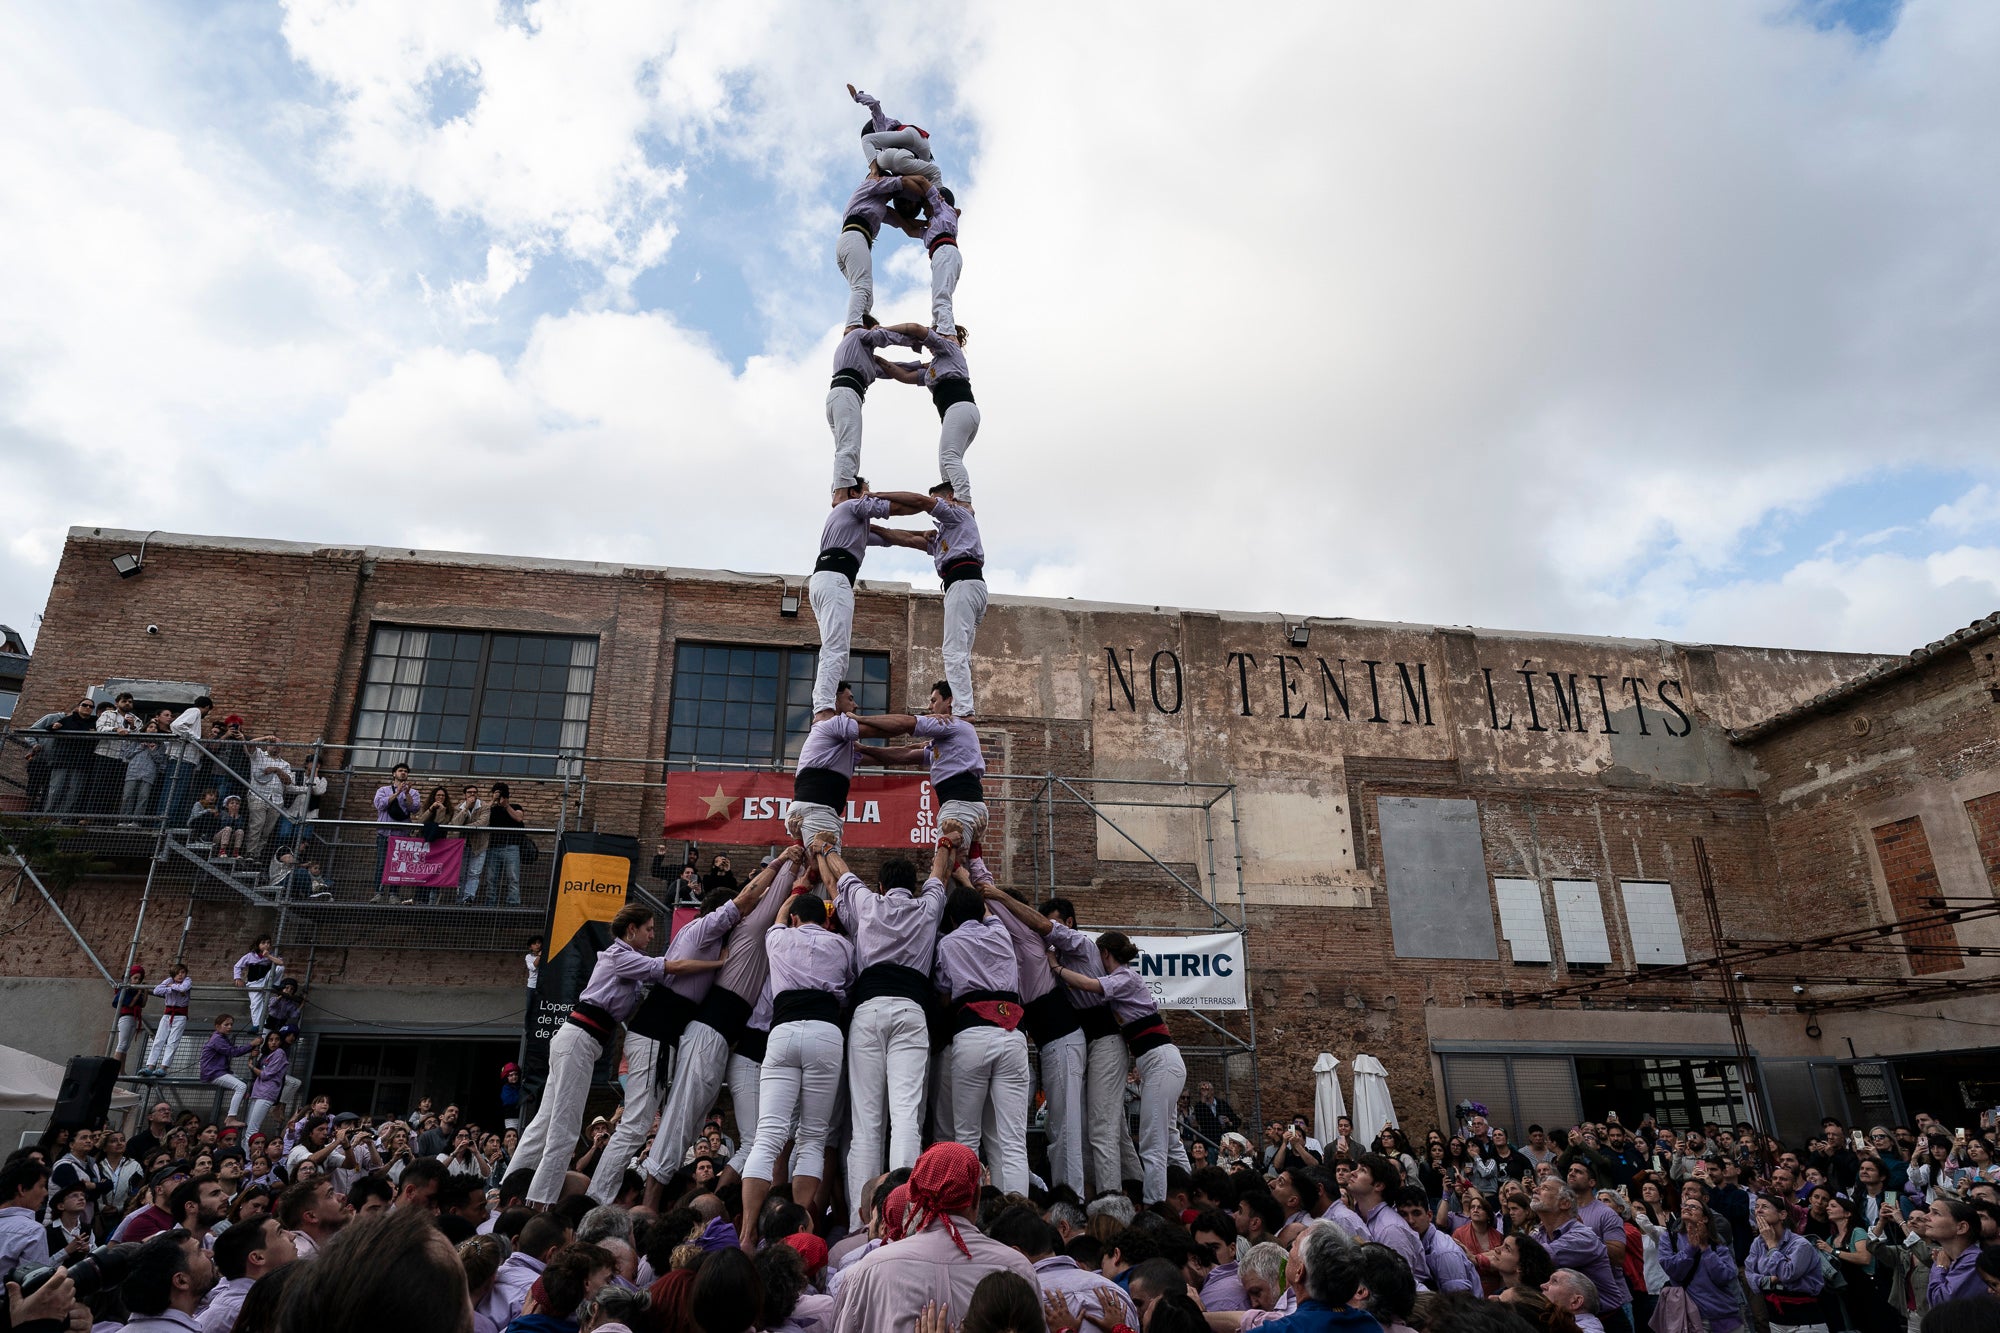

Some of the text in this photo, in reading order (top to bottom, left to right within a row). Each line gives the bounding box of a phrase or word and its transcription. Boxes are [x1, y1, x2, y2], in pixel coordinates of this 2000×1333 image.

[1103, 647, 1691, 737] NO TENIM LÍMITS
[742, 796, 881, 823] ESTLA
[395, 839, 430, 853] TERRA
[392, 850, 426, 863] SENSE
[390, 861, 443, 875] RACISME
[563, 878, 622, 895] parlem
[1129, 953, 1233, 977] ENTRIC
[1177, 996, 1198, 1005] 08221
[1200, 996, 1236, 1005] TERRASSA
[537, 1014, 552, 1024] de
[535, 1028, 550, 1038] de
